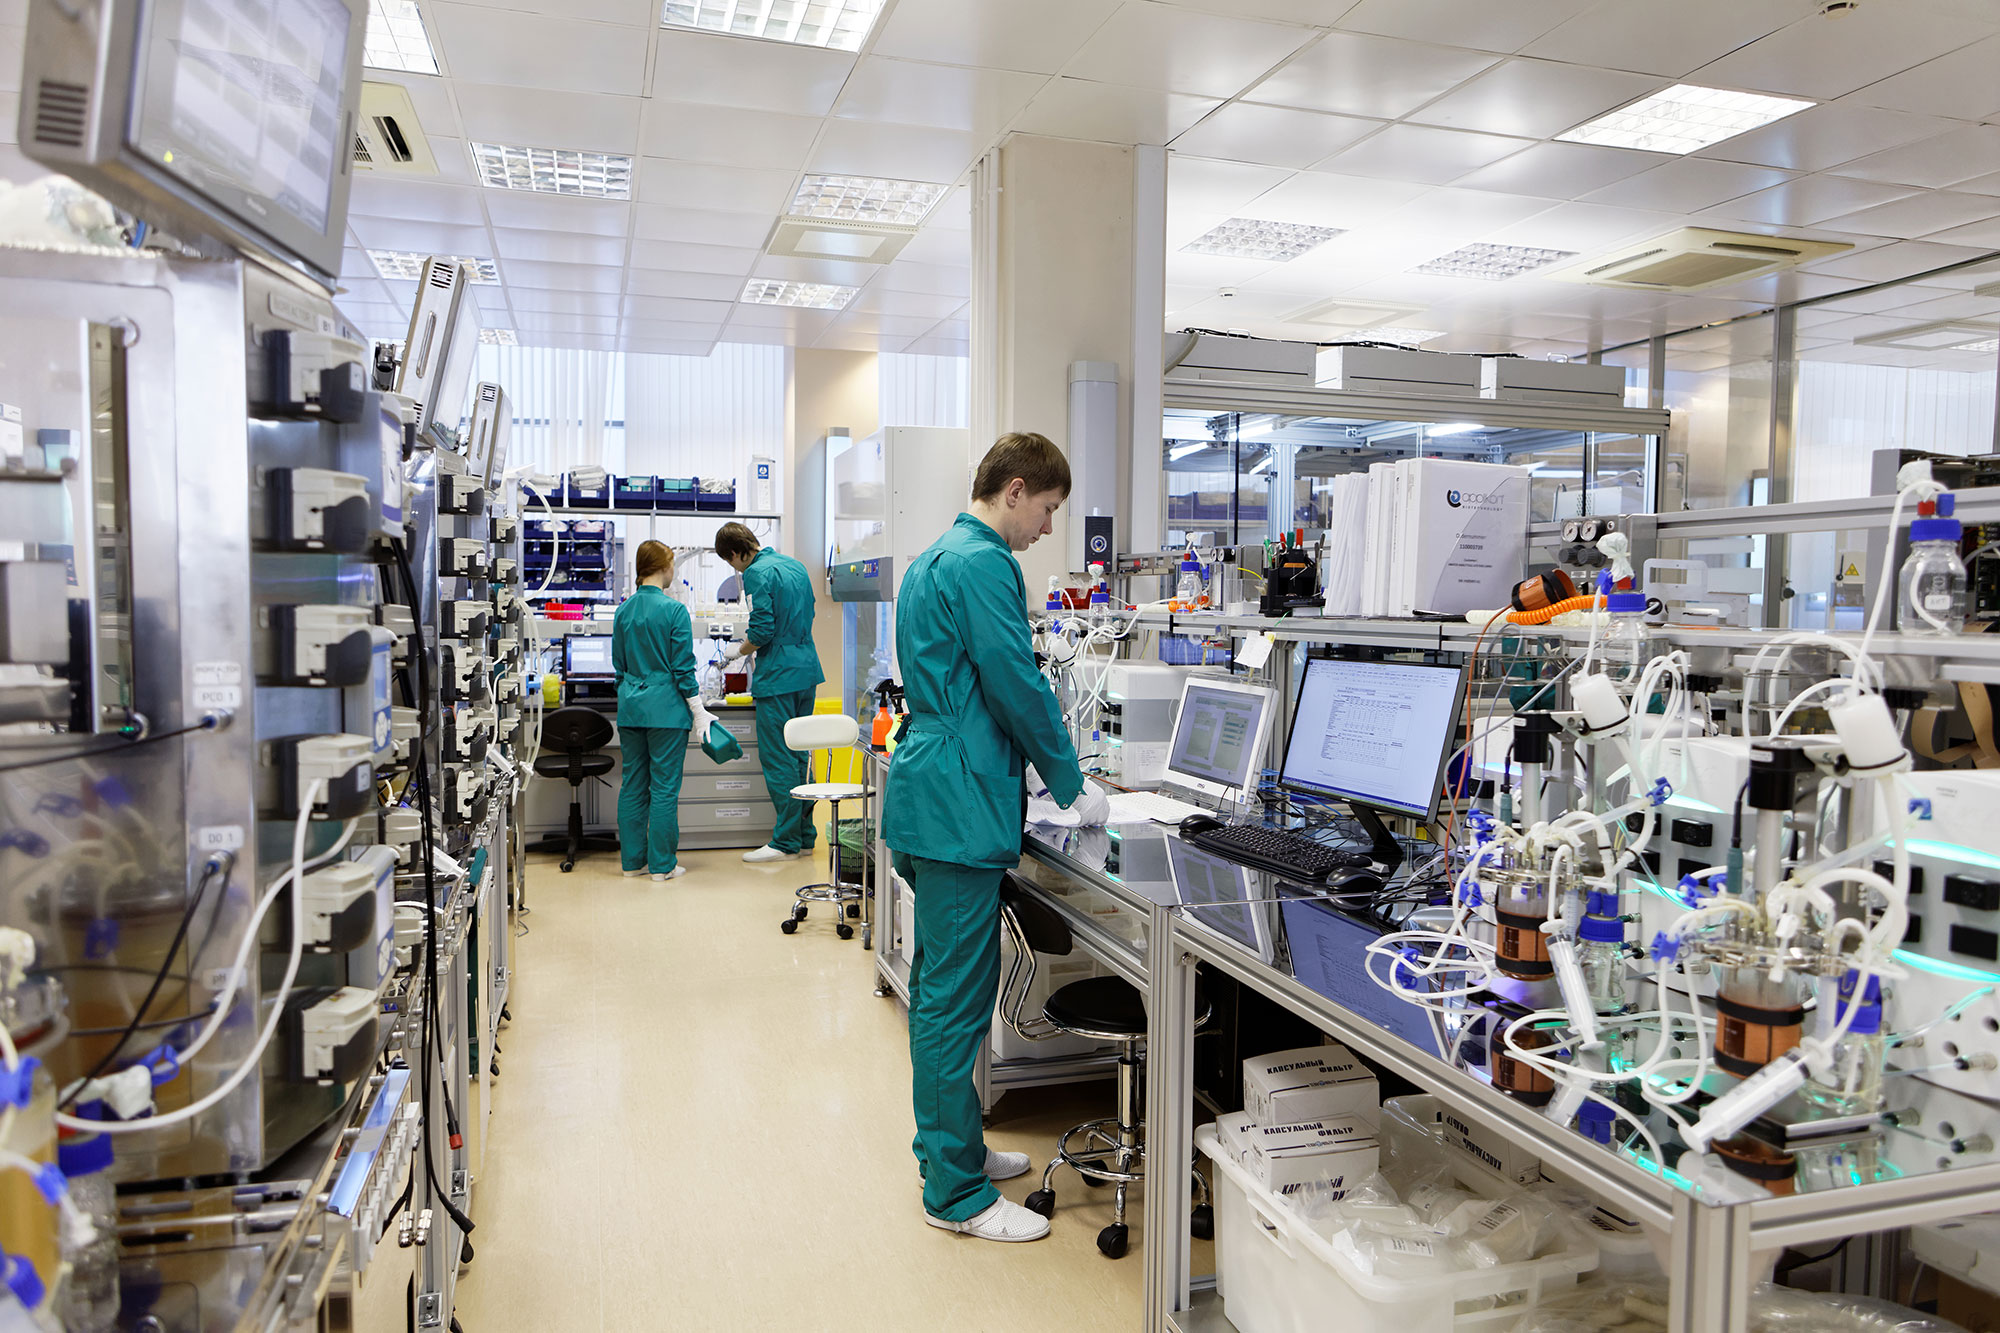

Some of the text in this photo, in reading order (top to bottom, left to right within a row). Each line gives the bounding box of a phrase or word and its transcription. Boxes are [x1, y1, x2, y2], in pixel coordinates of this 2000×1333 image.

[1267, 1059, 1324, 1074] КАПСУЛЬНЫЙ
[1319, 1064, 1354, 1073] ФИЛЬТР
[1264, 1122, 1324, 1135] КАПСУЛЬНЫЙ
[1318, 1127, 1354, 1136] ФИЛЬТР
